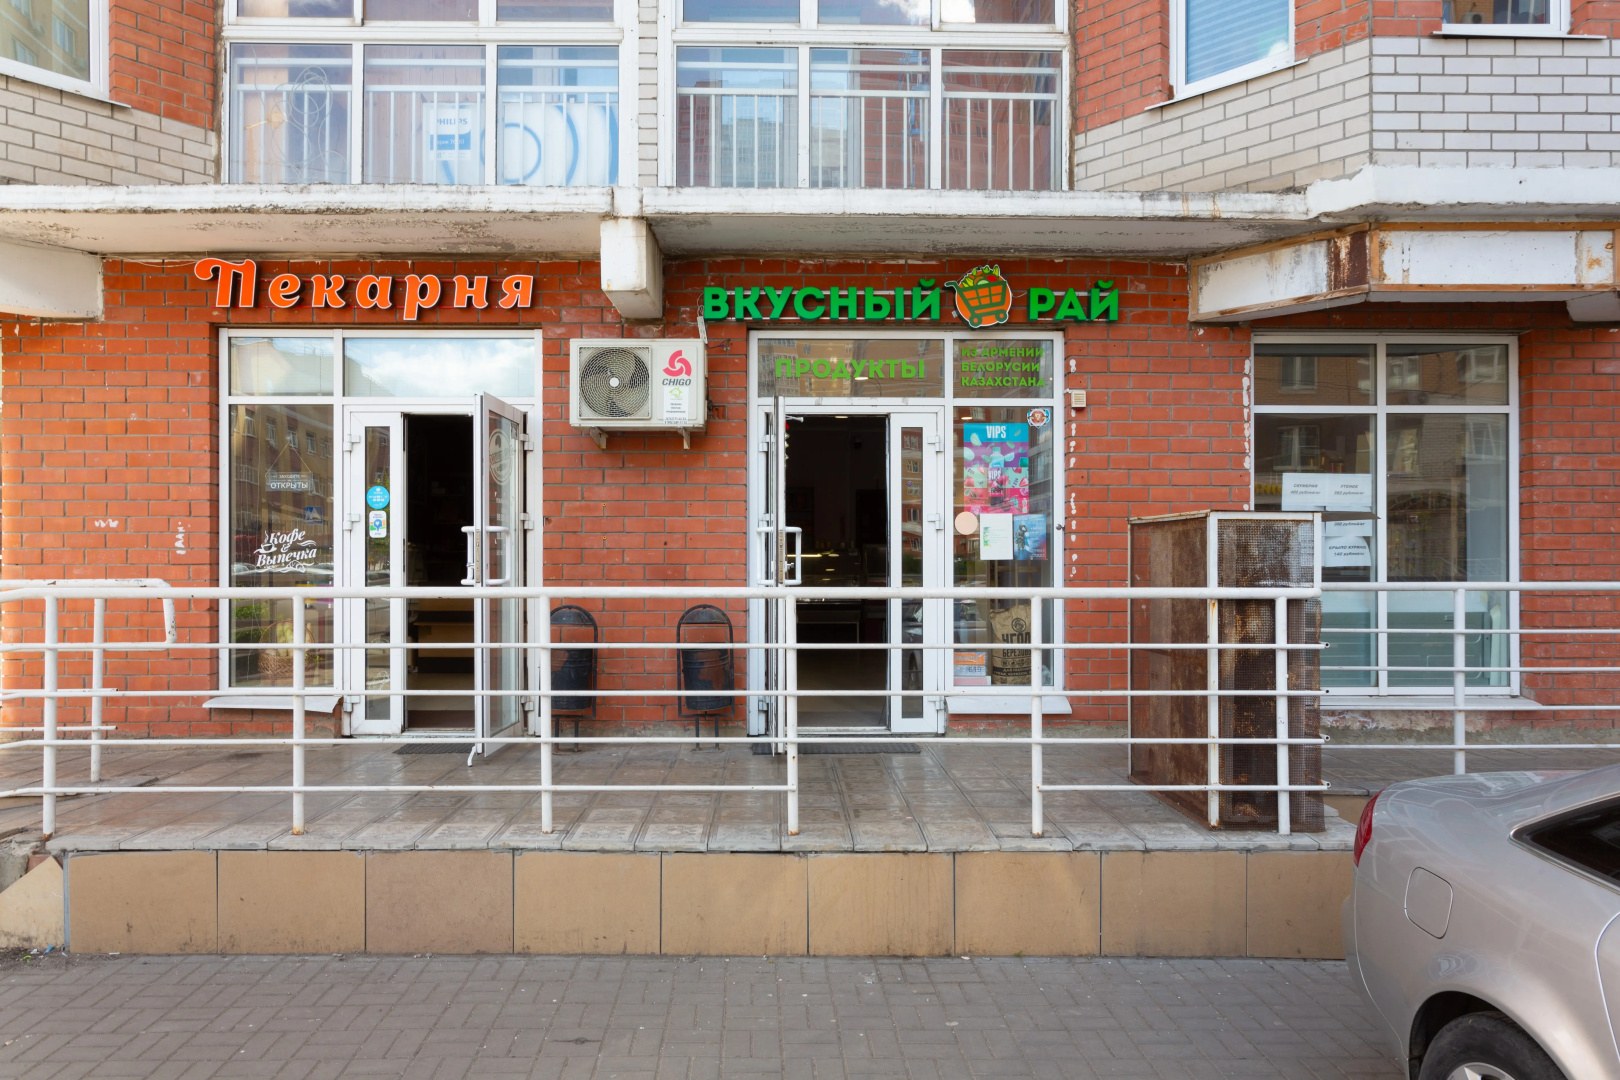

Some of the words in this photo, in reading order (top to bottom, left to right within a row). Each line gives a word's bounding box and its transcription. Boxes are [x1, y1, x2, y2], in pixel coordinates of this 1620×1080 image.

[194, 258, 534, 321] Пекарня
[703, 278, 941, 321] ВКУСНЫЙ
[1028, 279, 1119, 322] РАЙ
[961, 347, 978, 358] ИЗ
[980, 347, 1044, 358] АРМЕНИИ
[775, 358, 926, 381] ПРОДУКТЫ
[961, 361, 1040, 372] БЕЛОРУСИИ
[961, 376, 1046, 387] КАЗАХСТАНА
[986, 426, 1006, 439] VIPS
[270, 528, 306, 544] Кофе
[281, 543, 290, 553] &
[256, 548, 318, 567] Выпечка
[1002, 632, 1031, 644] УГОЛ
